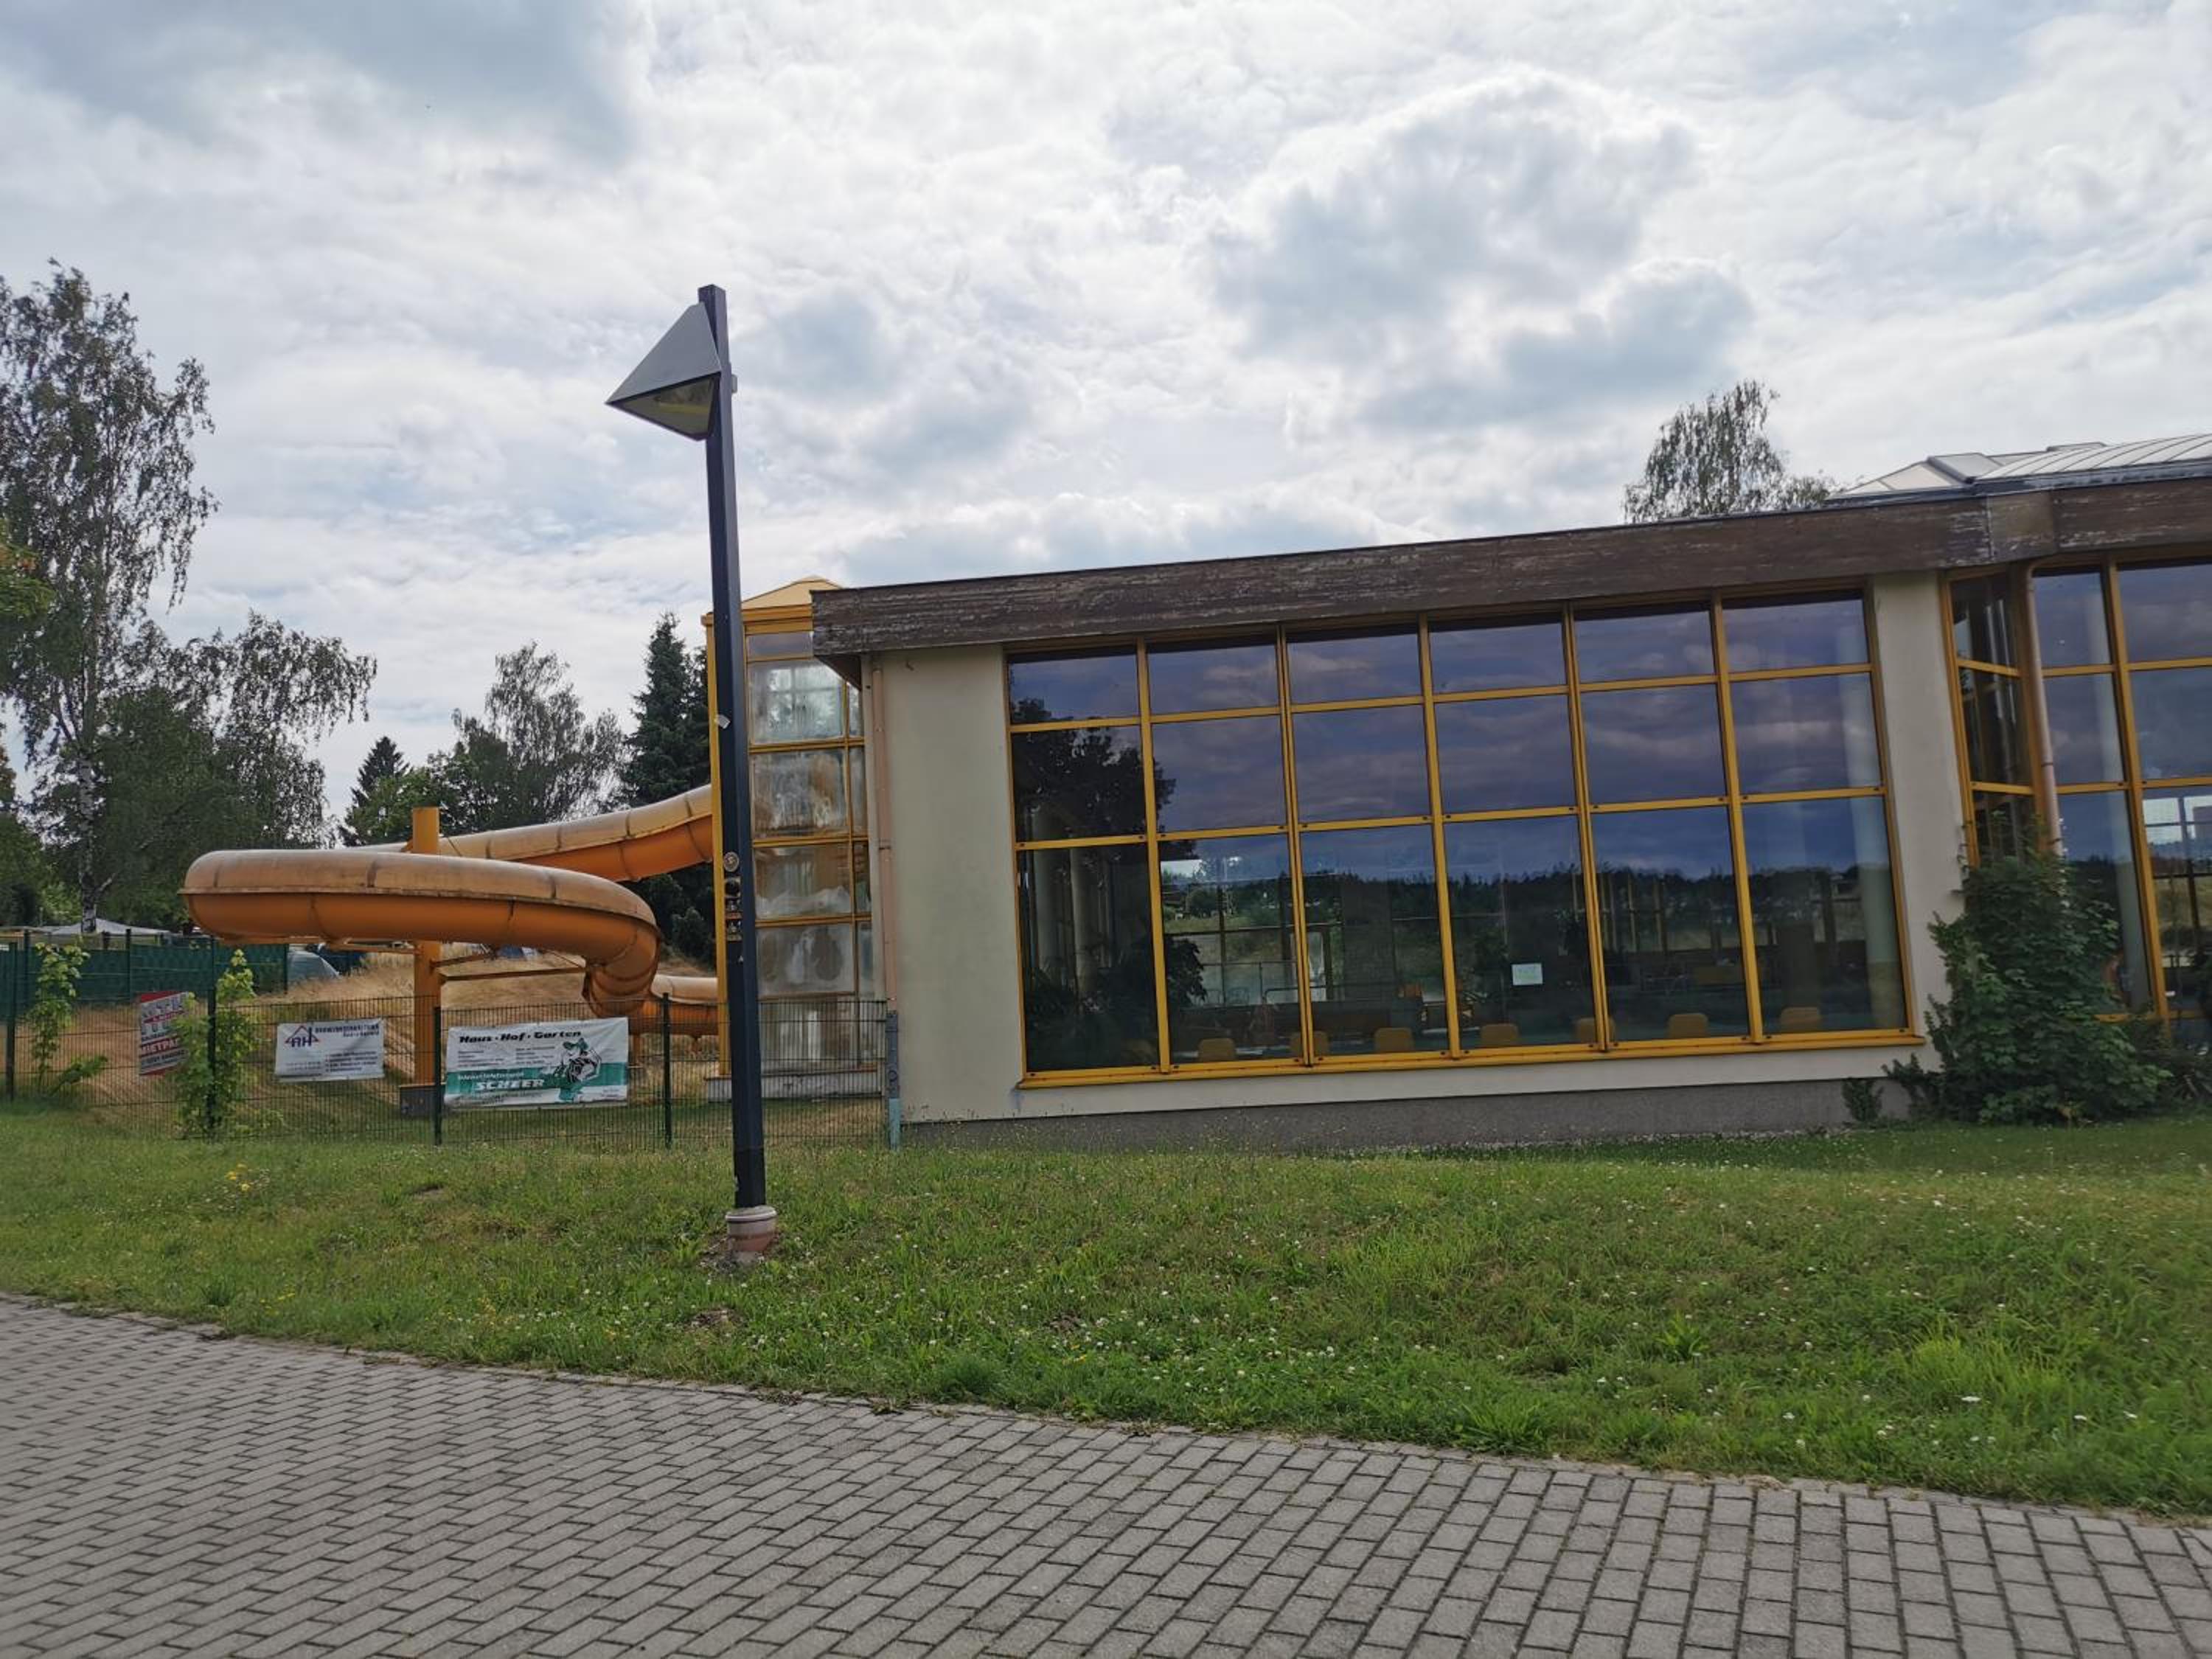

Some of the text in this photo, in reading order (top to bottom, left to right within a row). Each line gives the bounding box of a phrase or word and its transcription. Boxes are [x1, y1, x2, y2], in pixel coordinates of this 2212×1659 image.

[459, 1031, 582, 1043] Haus Hof Garten
